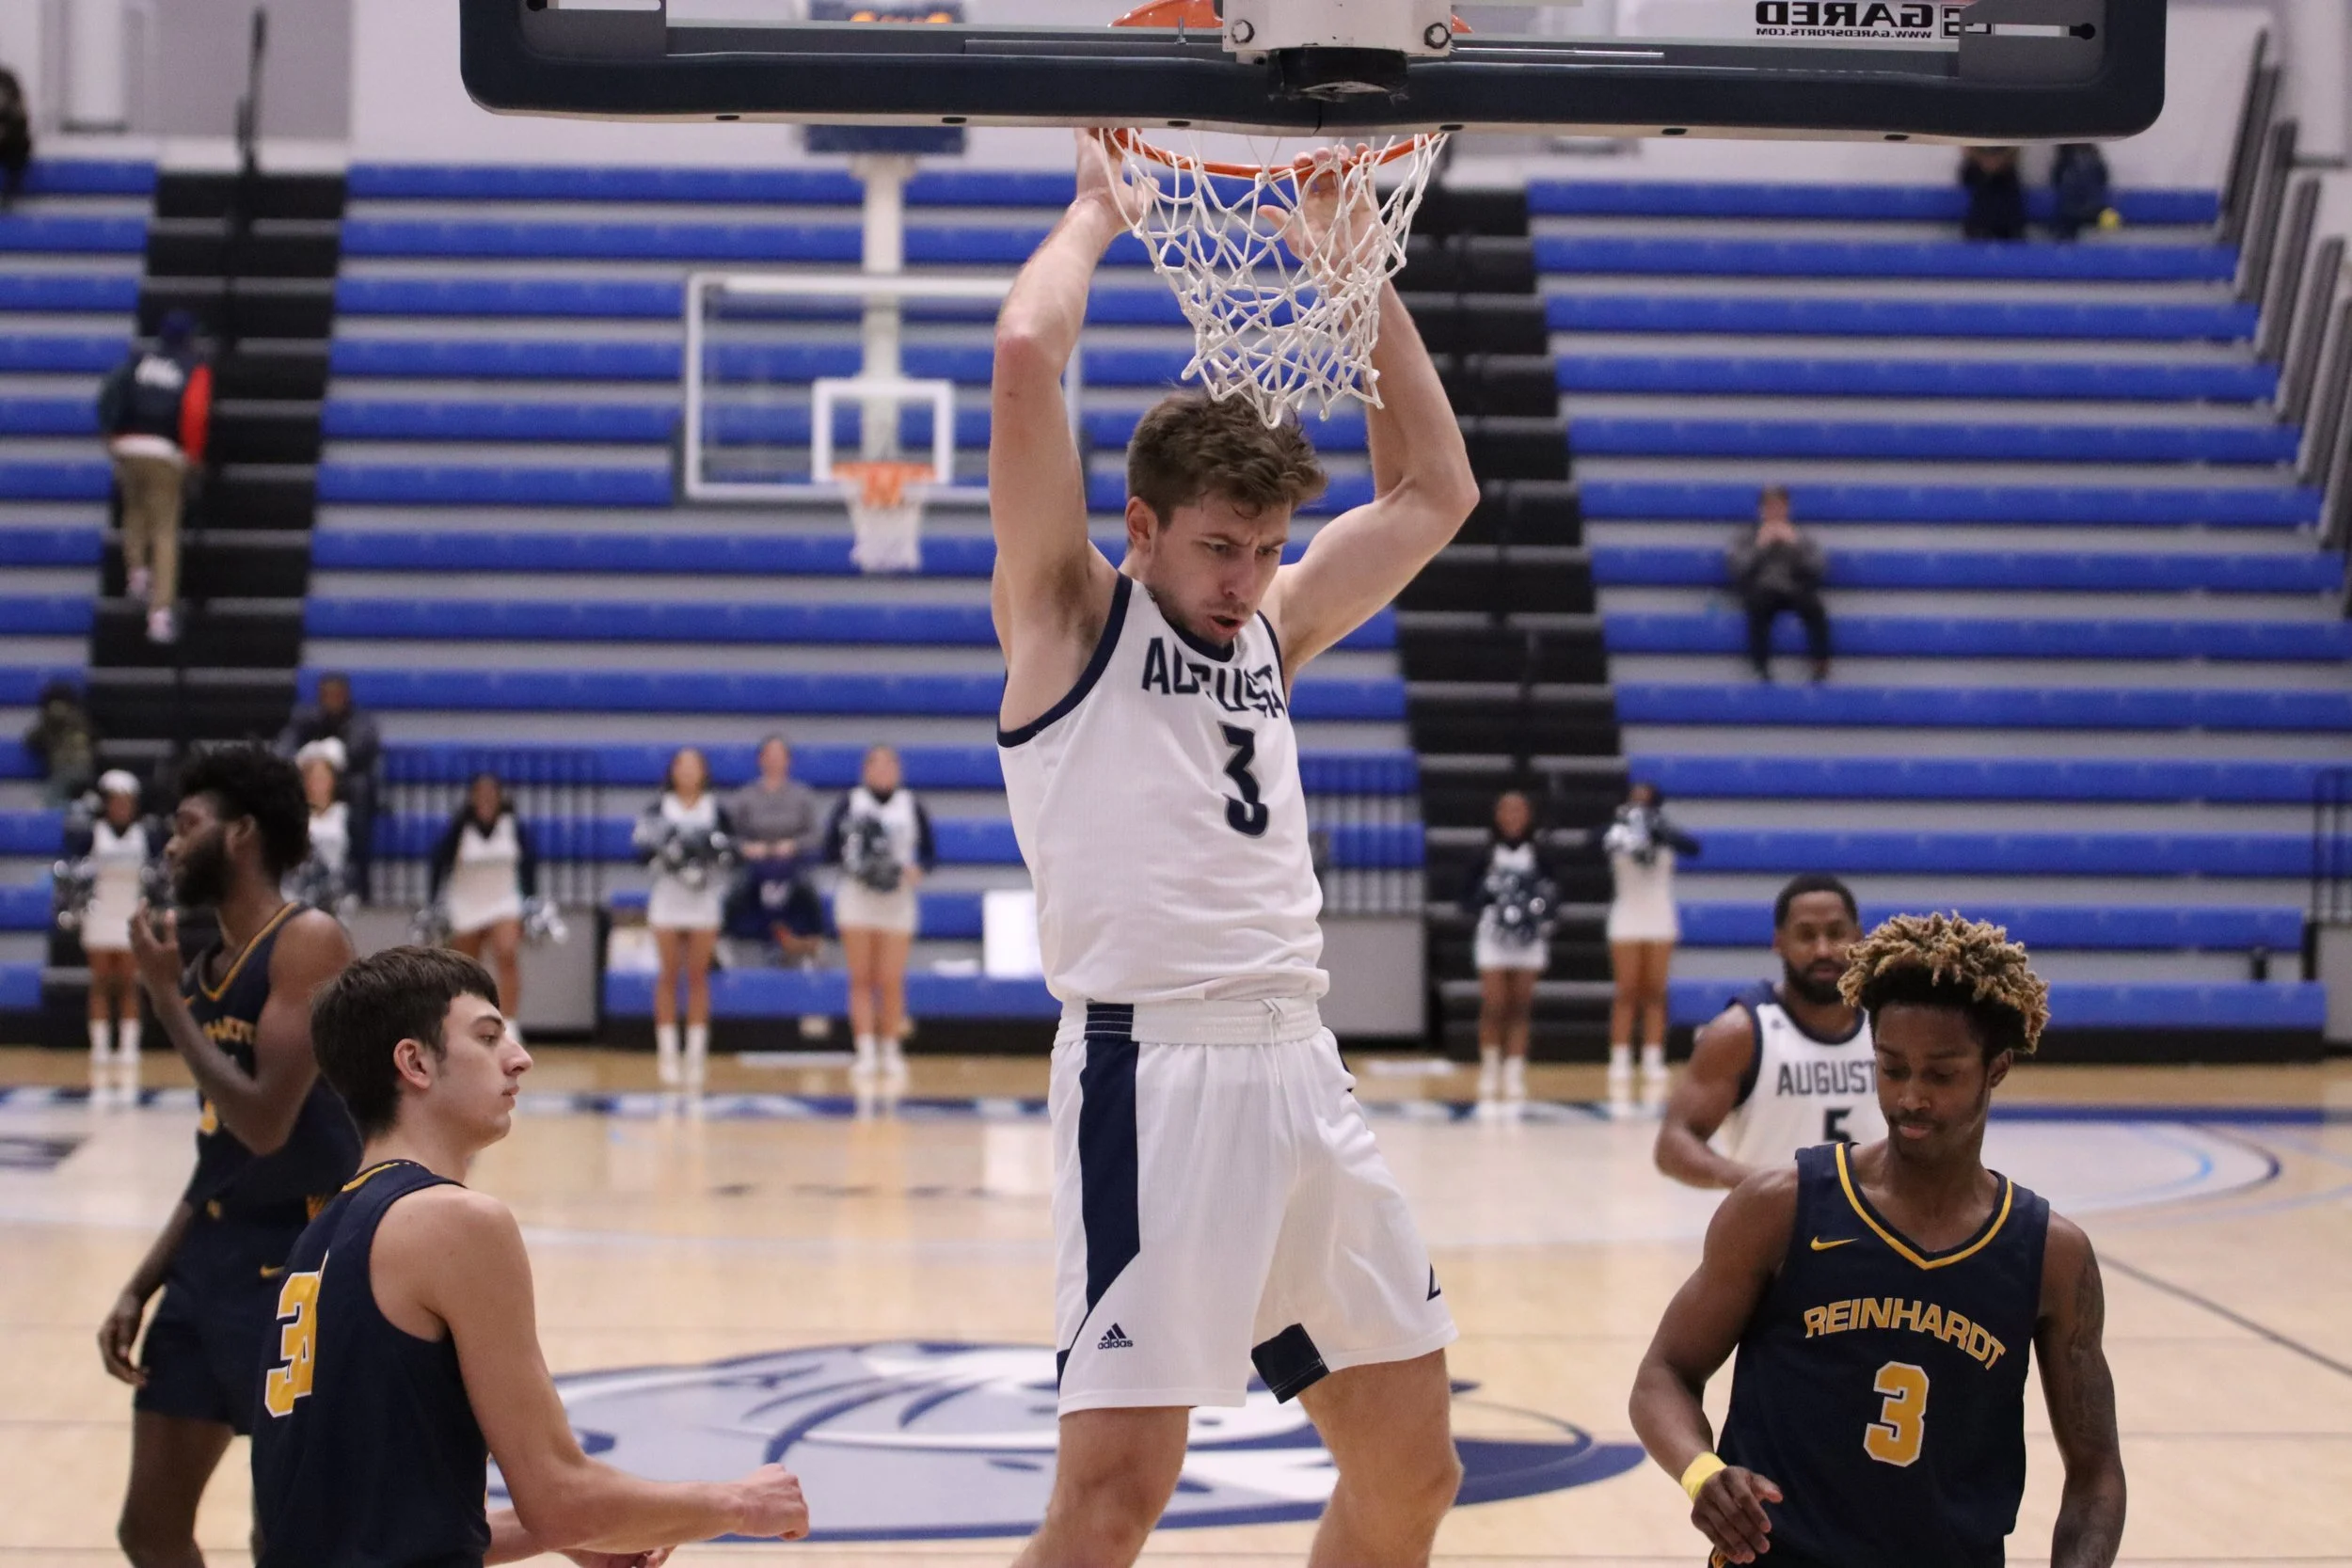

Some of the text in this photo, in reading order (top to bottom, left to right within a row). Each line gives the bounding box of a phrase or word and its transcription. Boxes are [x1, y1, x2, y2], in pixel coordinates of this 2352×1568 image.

[1217, 721, 1269, 839] 3
[1097, 1338, 1134, 1350] adidas
[1804, 1297, 2006, 1370] REINHARDT
[1864, 1361, 1930, 1467] 3
